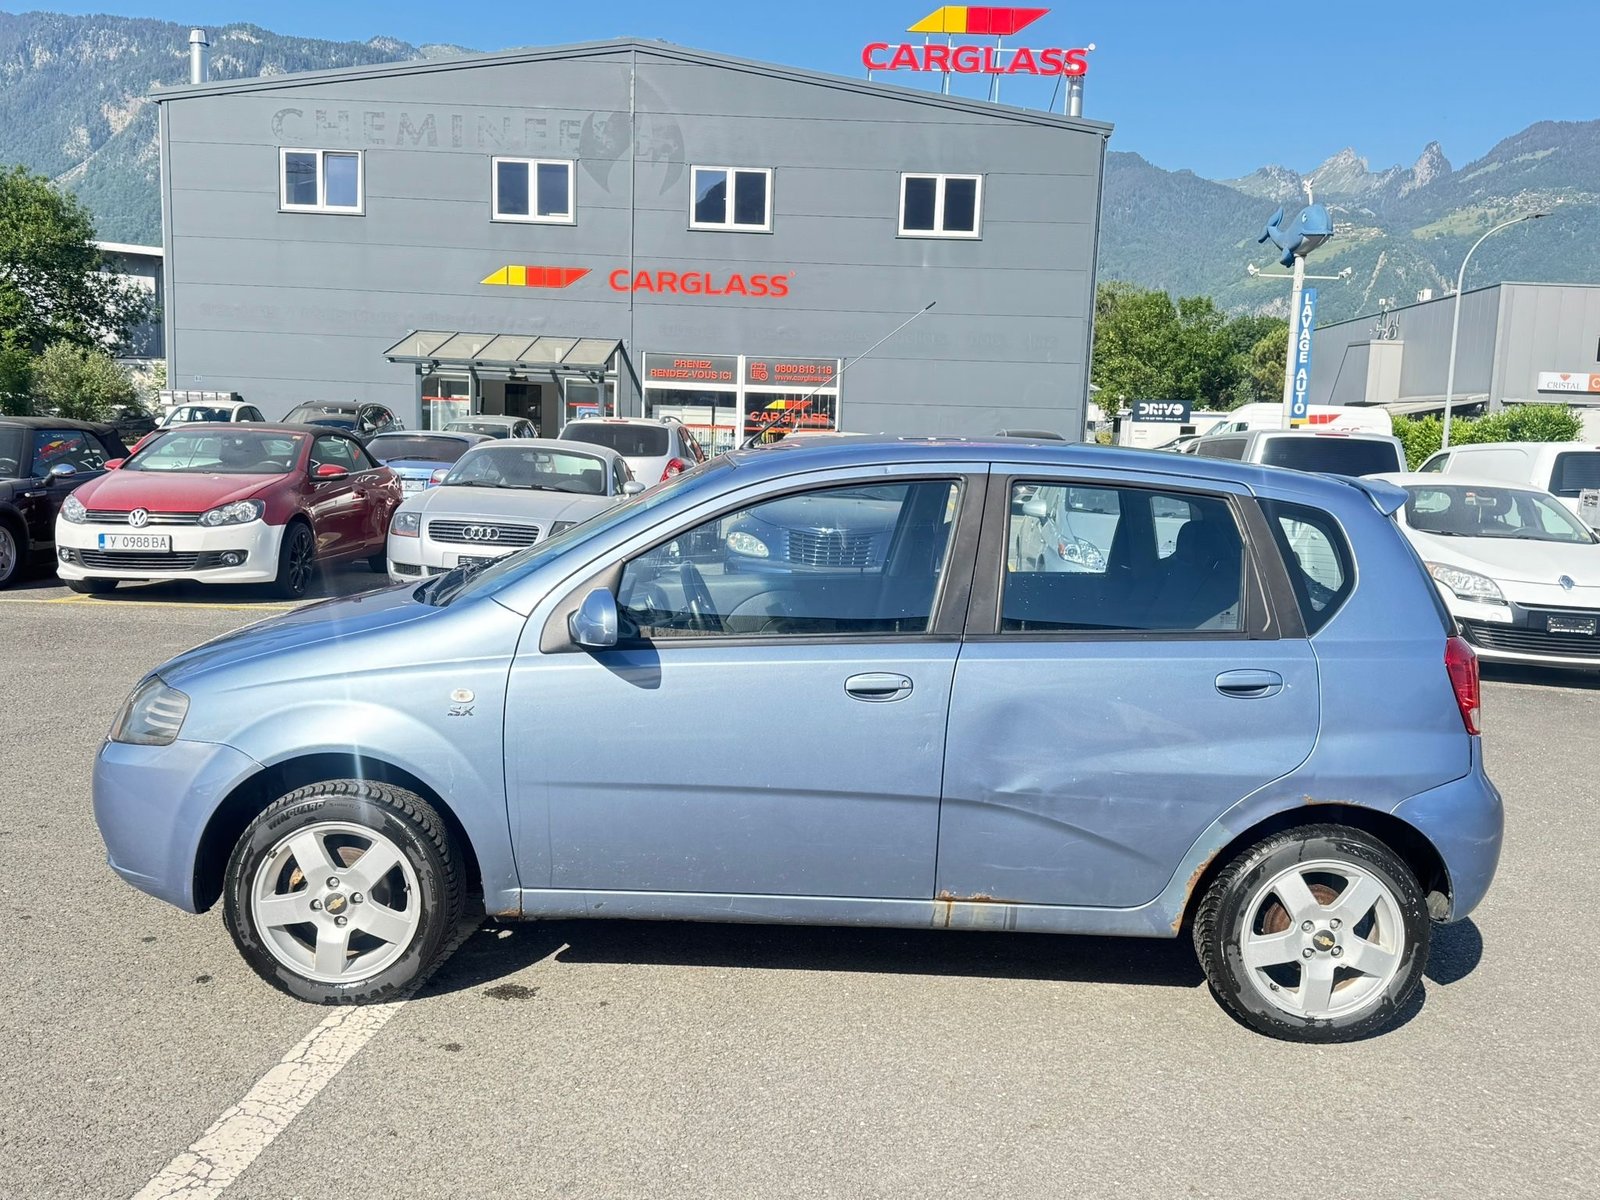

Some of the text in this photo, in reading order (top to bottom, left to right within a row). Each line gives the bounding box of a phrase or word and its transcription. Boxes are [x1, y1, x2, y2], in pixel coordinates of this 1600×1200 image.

[861, 42, 1089, 76] CARGLASS
[608, 268, 789, 297] CARGLASS
[1293, 293, 1313, 415] LAVAGE AUTO
[673, 359, 712, 369] PRENEZ
[774, 364, 832, 375] 0800 818 118
[650, 368, 732, 380] RENDEZ-VOUS ICI
[1546, 381, 1581, 390] CRISTAL
